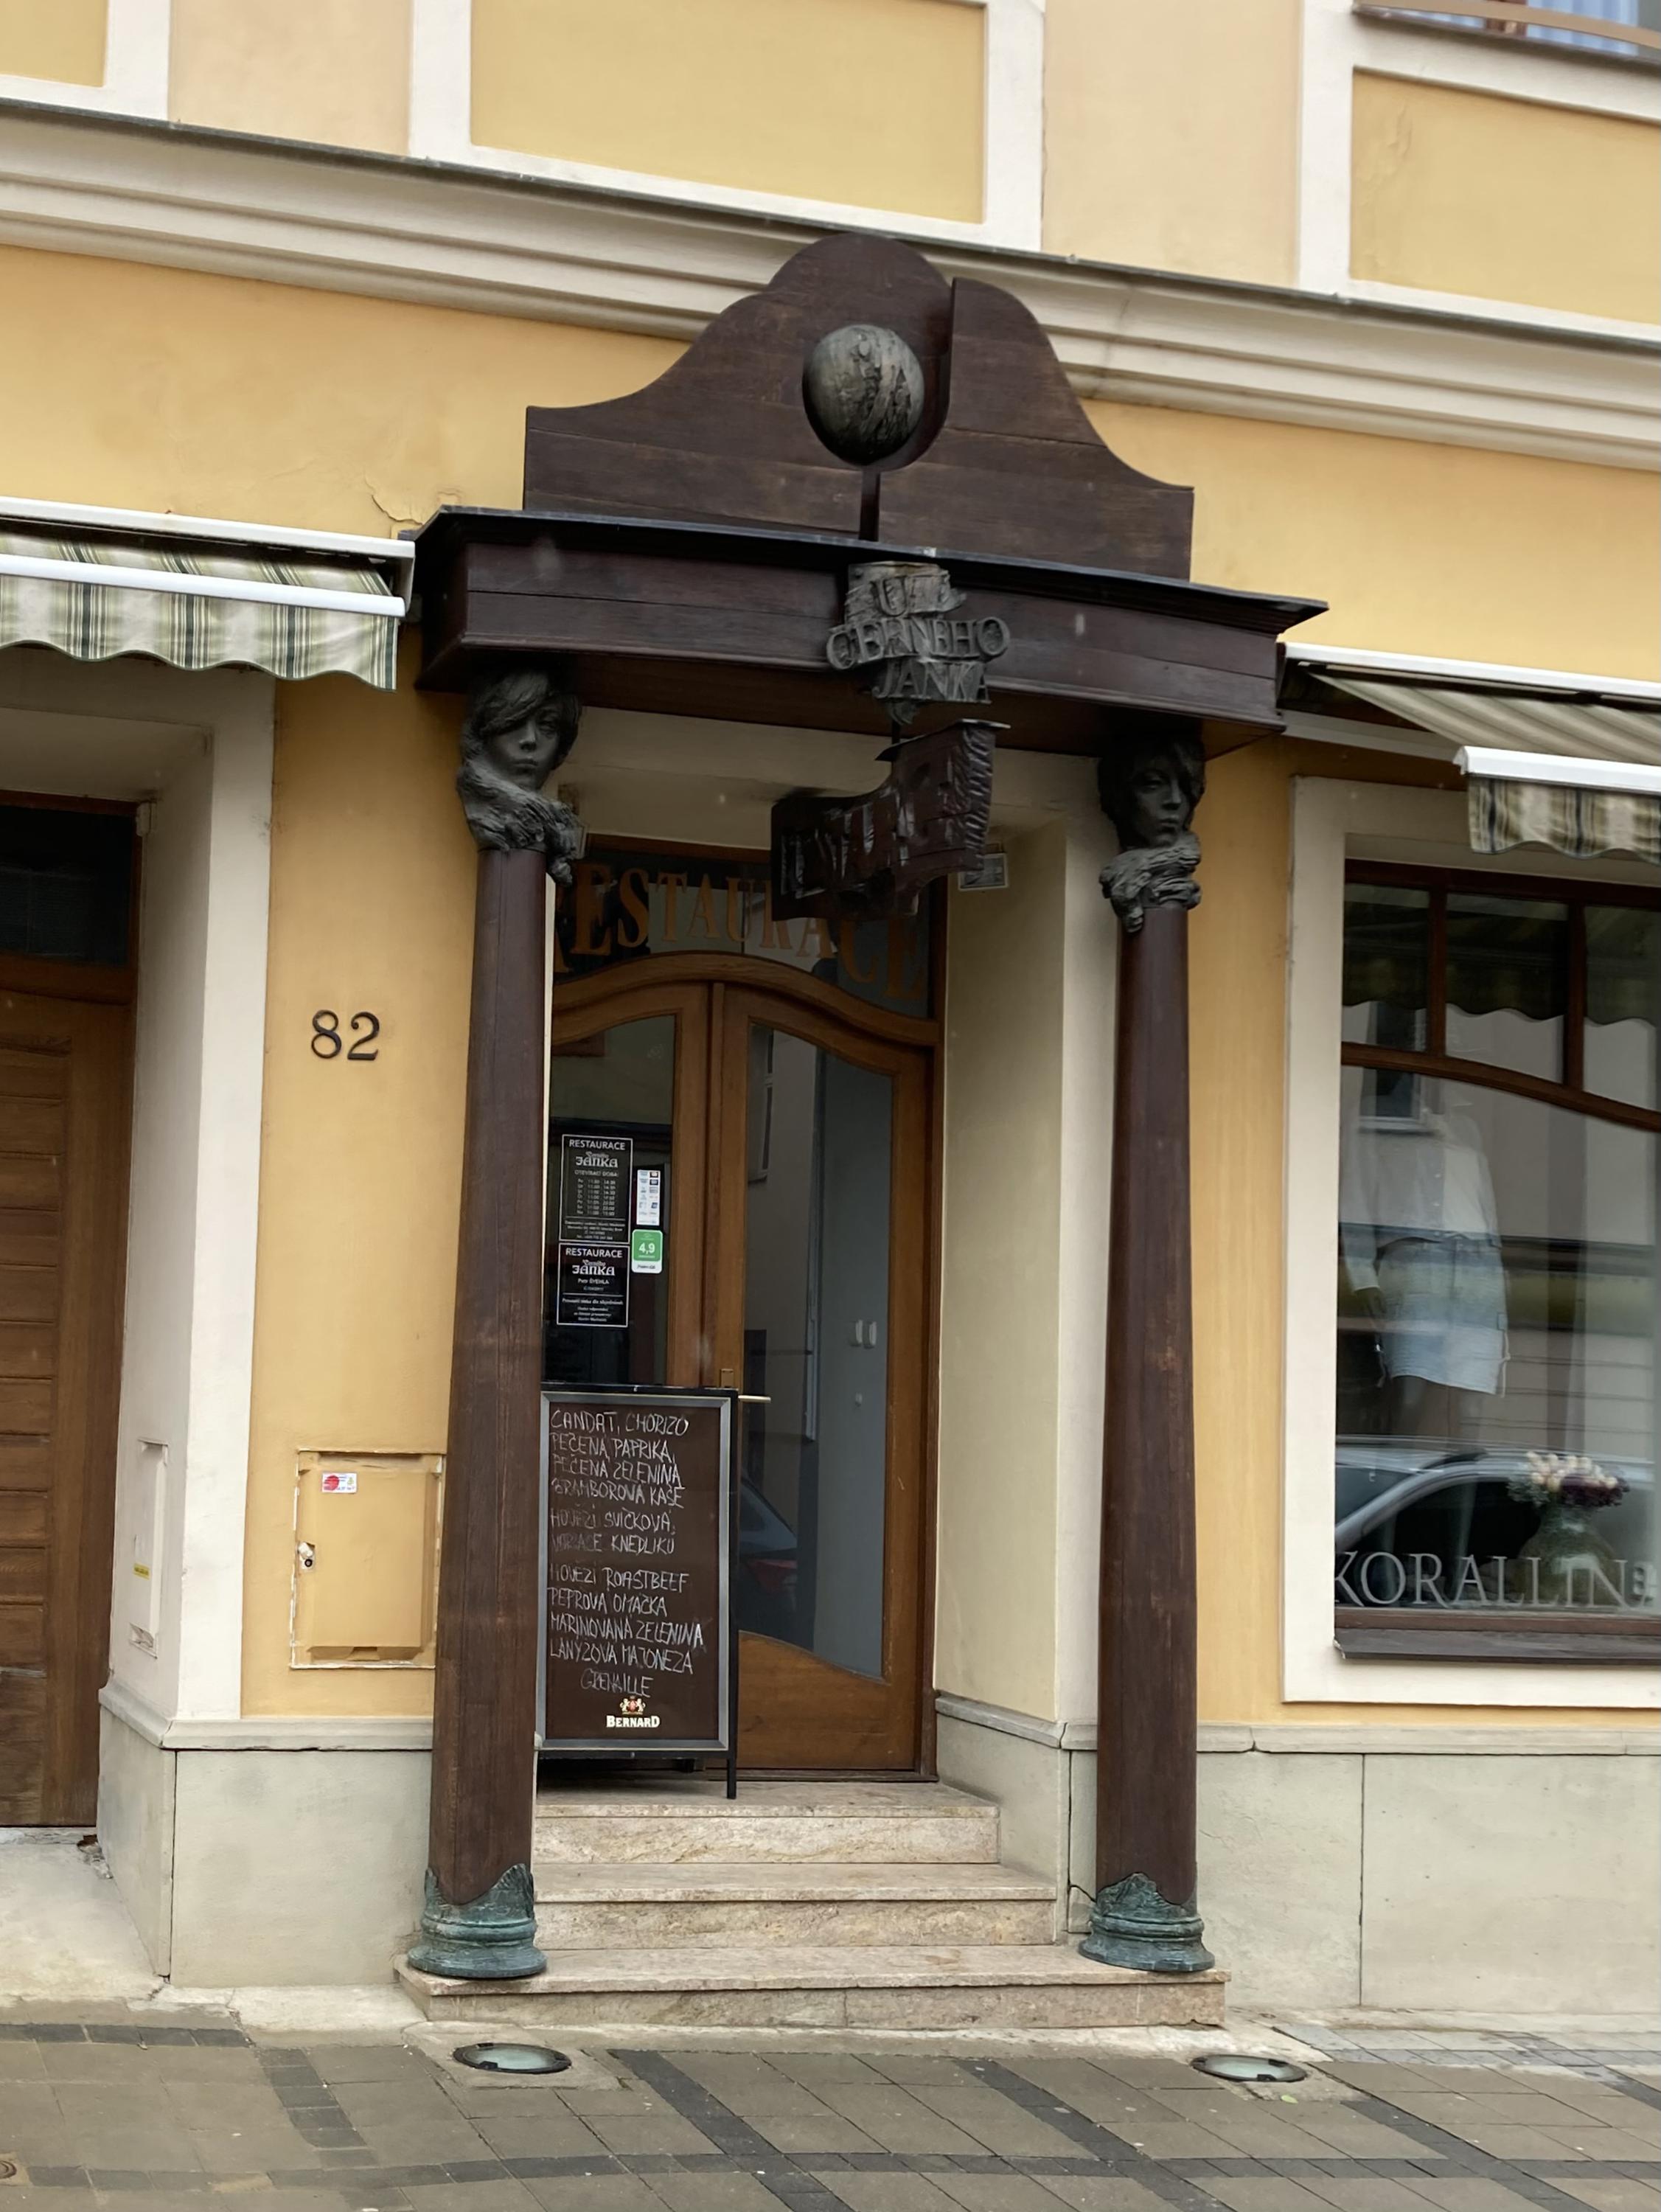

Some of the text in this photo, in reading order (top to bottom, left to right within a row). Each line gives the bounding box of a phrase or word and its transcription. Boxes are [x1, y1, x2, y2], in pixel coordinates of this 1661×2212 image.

[871, 658, 992, 706] JANKA
[311, 1009, 380, 1060] 82
[569, 1139, 626, 1150] RESTAURACE
[565, 1248, 623, 1258] RESTAURACE
[638, 1242, 655, 1254] 4,9
